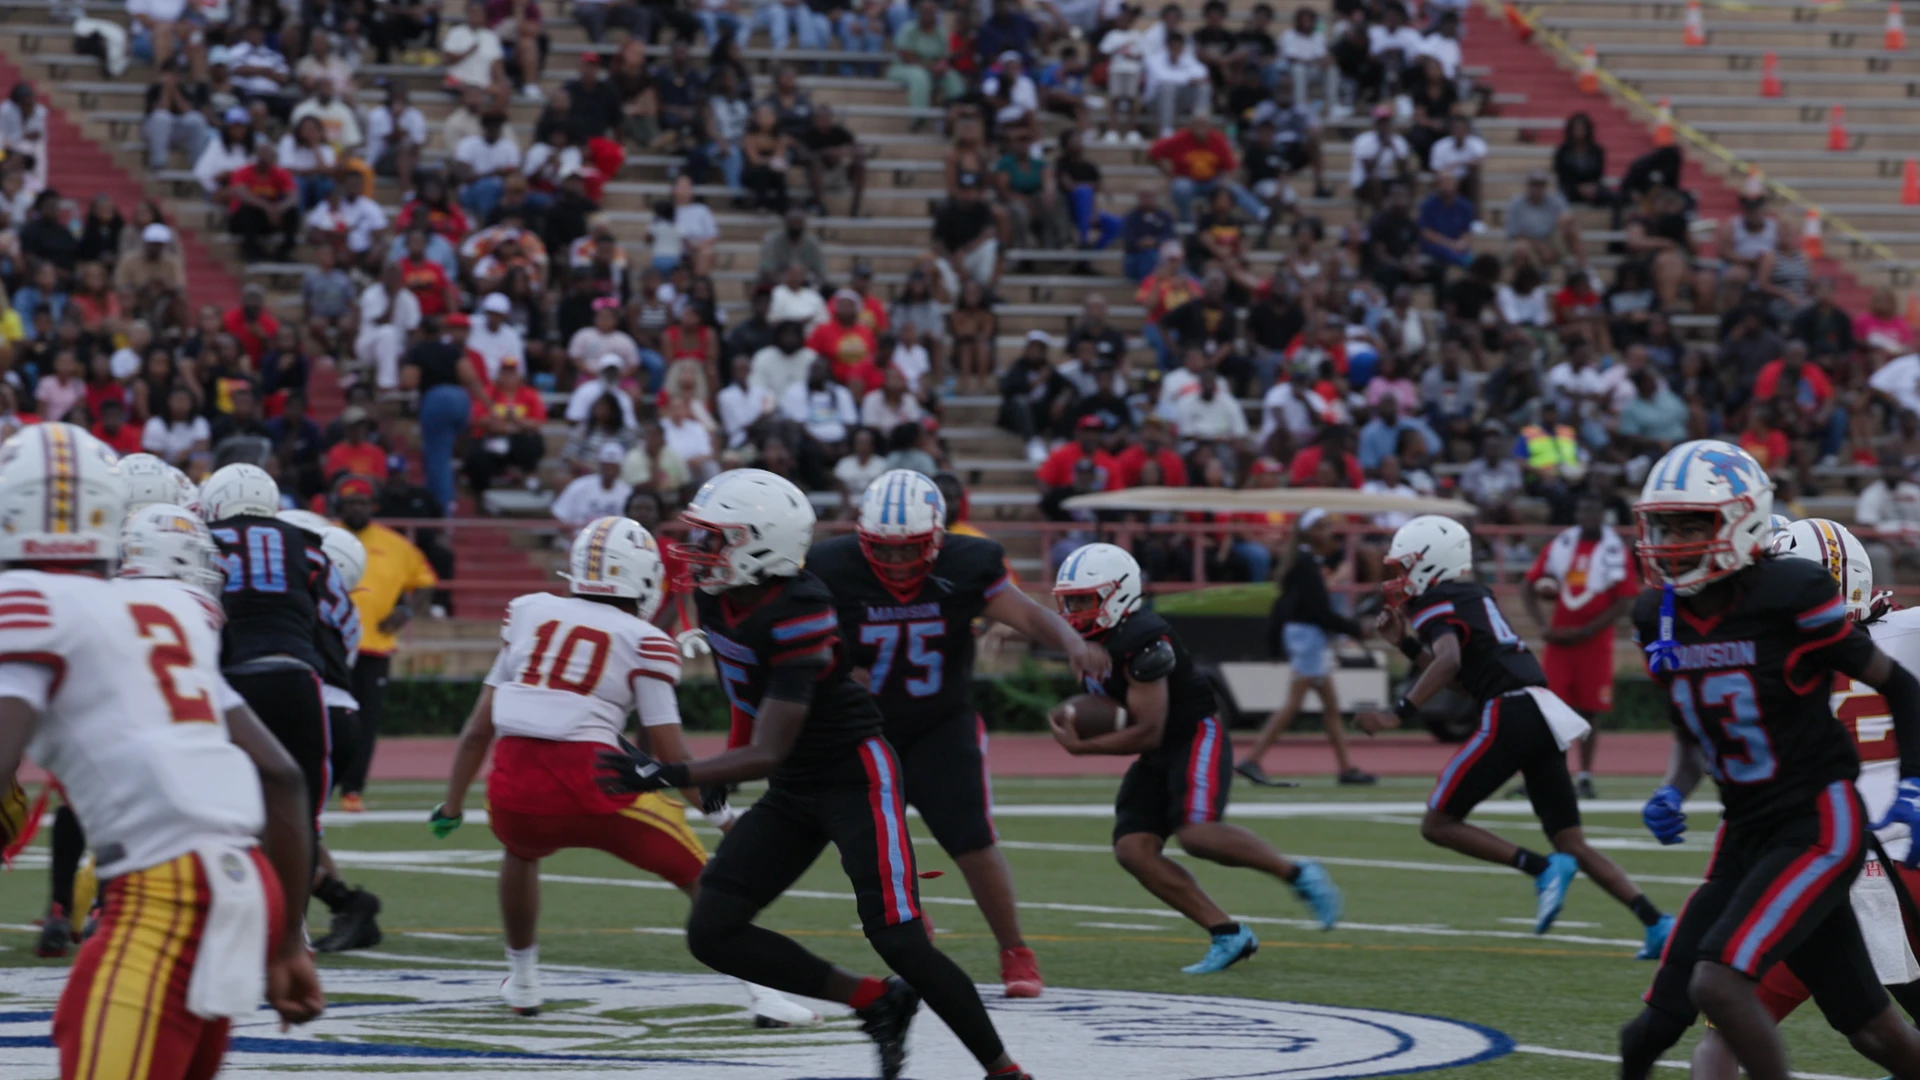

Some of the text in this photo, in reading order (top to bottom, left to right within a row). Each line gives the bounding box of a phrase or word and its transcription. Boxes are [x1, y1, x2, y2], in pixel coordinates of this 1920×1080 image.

[867, 602, 942, 622] MADISON
[127, 603, 218, 723] 2
[521, 619, 612, 697] 10
[858, 619, 947, 697] 75
[1664, 639, 1757, 671] ADISON
[1670, 668, 1778, 785] 13
